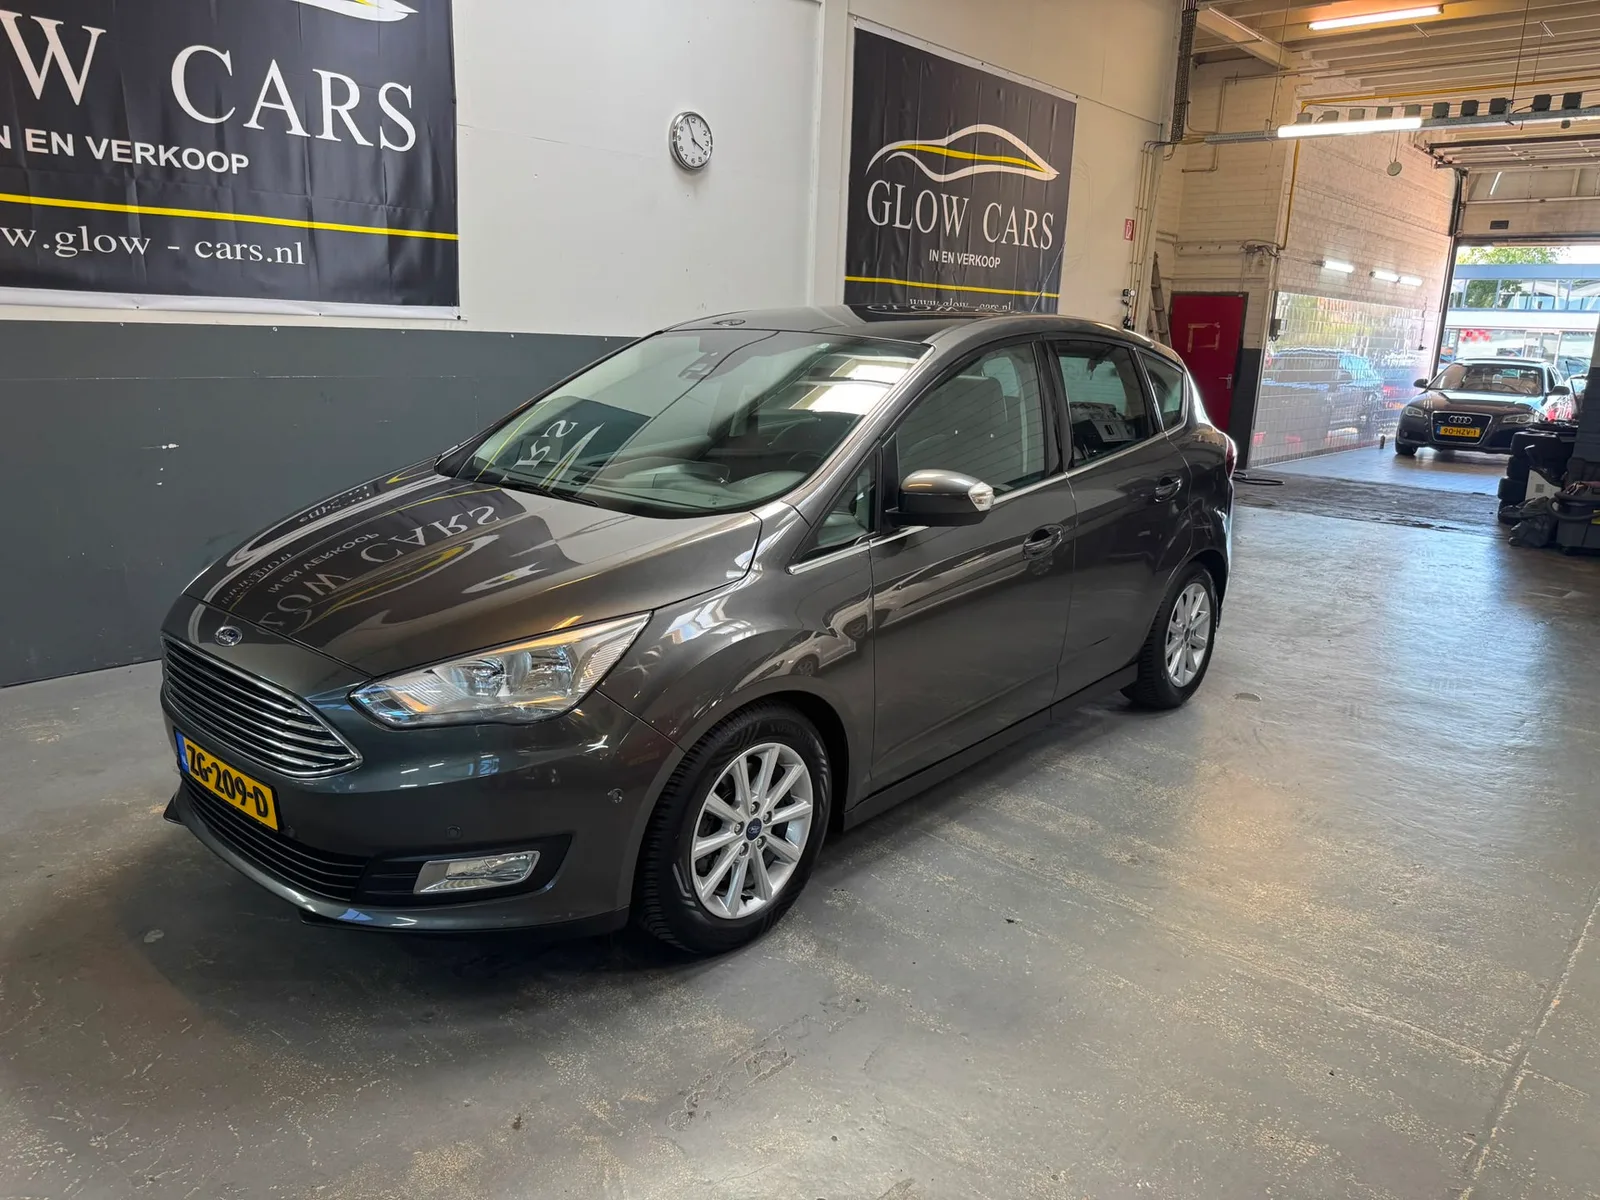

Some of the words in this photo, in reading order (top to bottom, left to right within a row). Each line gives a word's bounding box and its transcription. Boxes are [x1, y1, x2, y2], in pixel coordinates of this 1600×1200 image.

[0, 10, 106, 106] W
[170, 44, 417, 153] CARS
[25, 128, 75, 157] EN
[85, 135, 250, 175] VERKOOP
[866, 179, 970, 238] GLOW
[983, 202, 1054, 250] CARS
[194, 239, 306, 266] cars.nl
[929, 248, 939, 263] IN
[941, 250, 954, 265] EN
[957, 252, 1001, 269] VERKOOP
[187, 744, 268, 818] ZG-209-D
